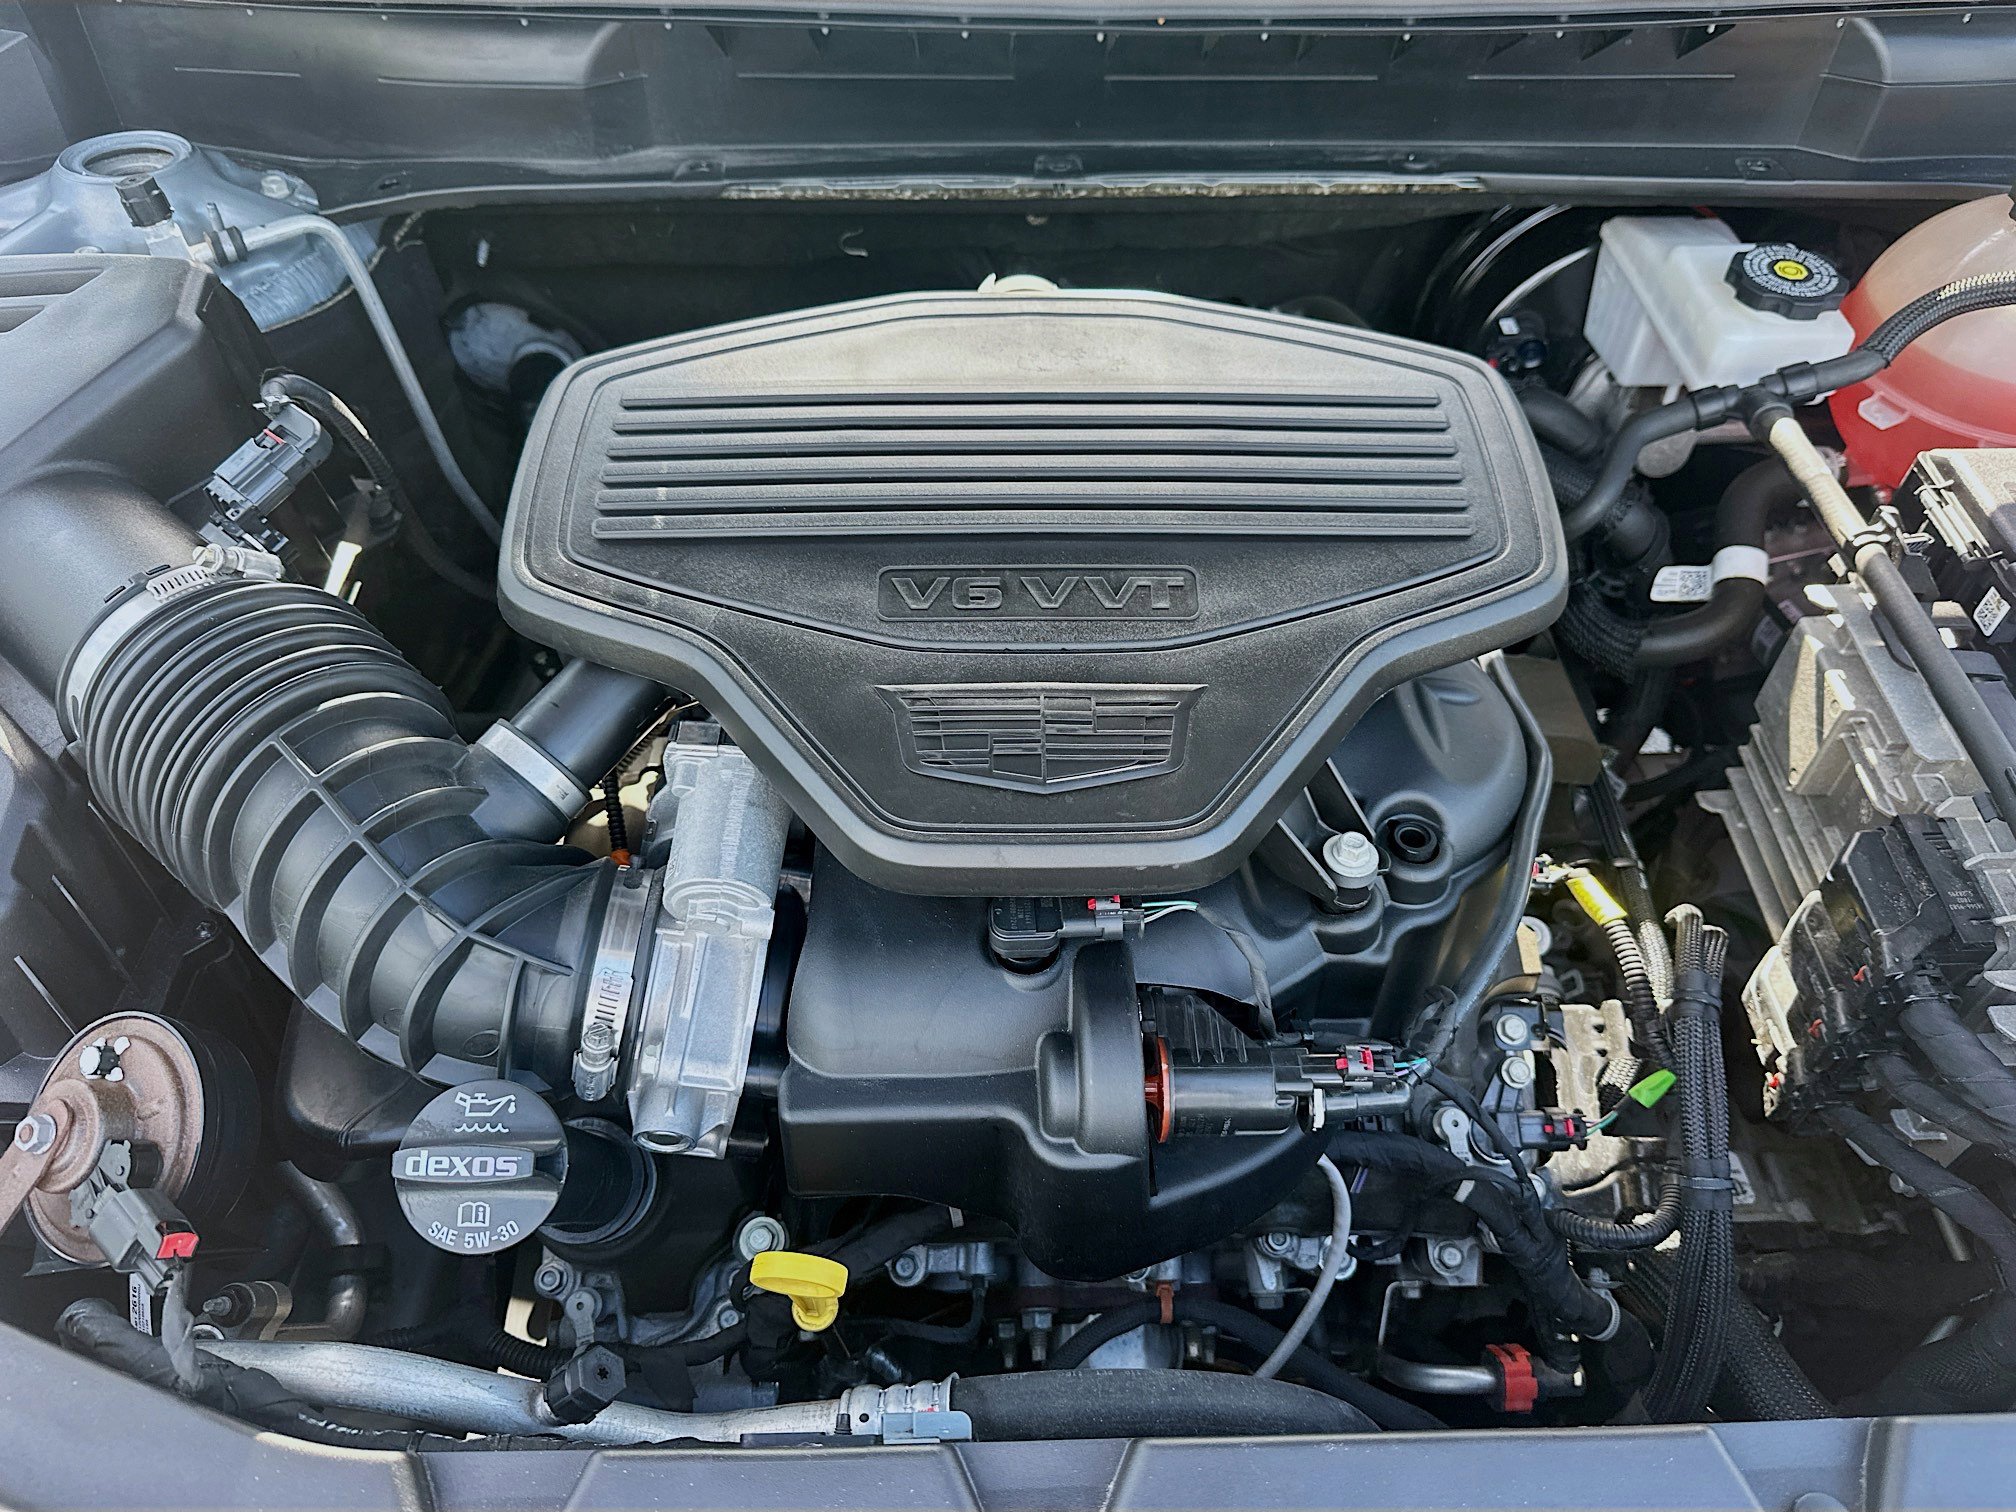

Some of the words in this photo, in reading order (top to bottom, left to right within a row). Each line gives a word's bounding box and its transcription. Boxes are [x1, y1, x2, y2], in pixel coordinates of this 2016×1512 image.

[891, 576, 1003, 610] V6
[1020, 576, 1185, 609] VVT
[405, 1150, 519, 1177] dexos
[427, 1220, 458, 1246] SAE
[464, 1220, 520, 1249] 5W-30
